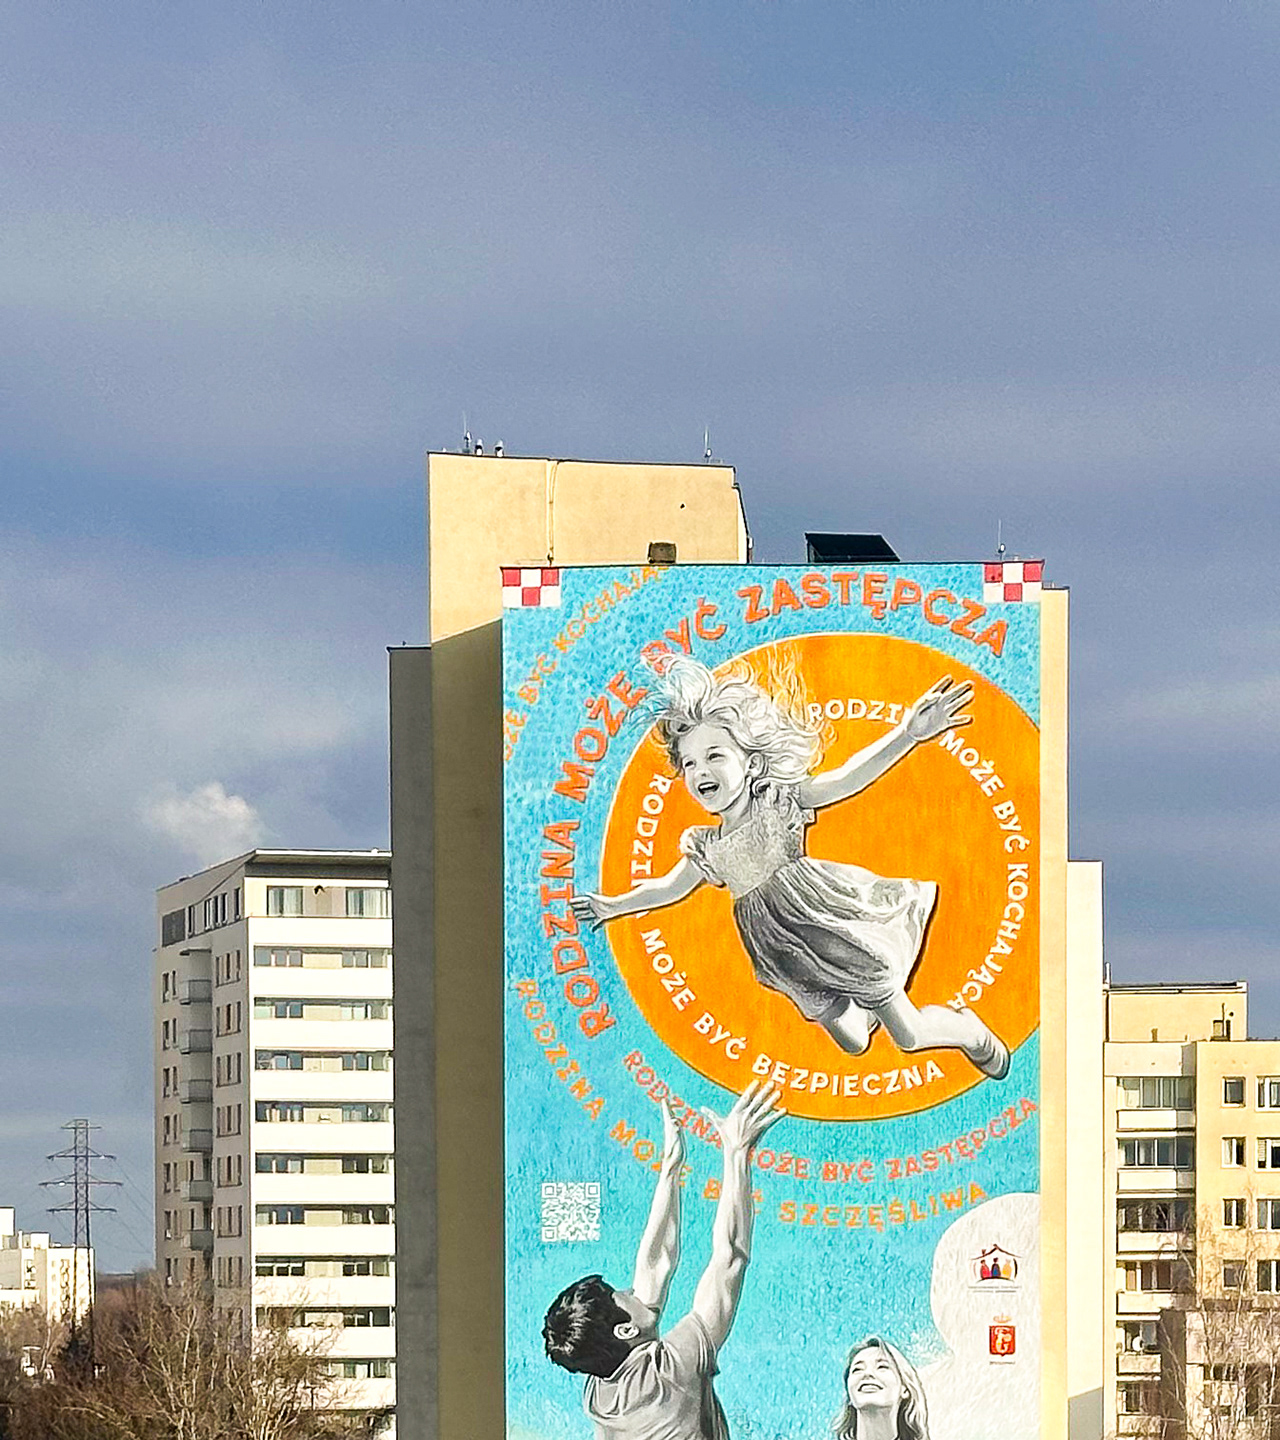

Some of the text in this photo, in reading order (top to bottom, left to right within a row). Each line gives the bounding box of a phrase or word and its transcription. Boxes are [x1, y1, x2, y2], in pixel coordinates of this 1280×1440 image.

[540, 571, 1009, 1039] RODZINA MOŻE BYĆ ZASTĘPCZA
[631, 774, 946, 1098] RODZI MOŻE BYĆ BEZPIECZNA
[807, 698, 1031, 1010] RODZI MOŻE BYĆ KOCHAJĄCA
[515, 979, 606, 1121] RODZINA
[778, 1182, 987, 1233] SZCZĘŚLIWA
[822, 1158, 875, 1184] BYĆ
[885, 1097, 1038, 1181] ZASTĘPCZA
